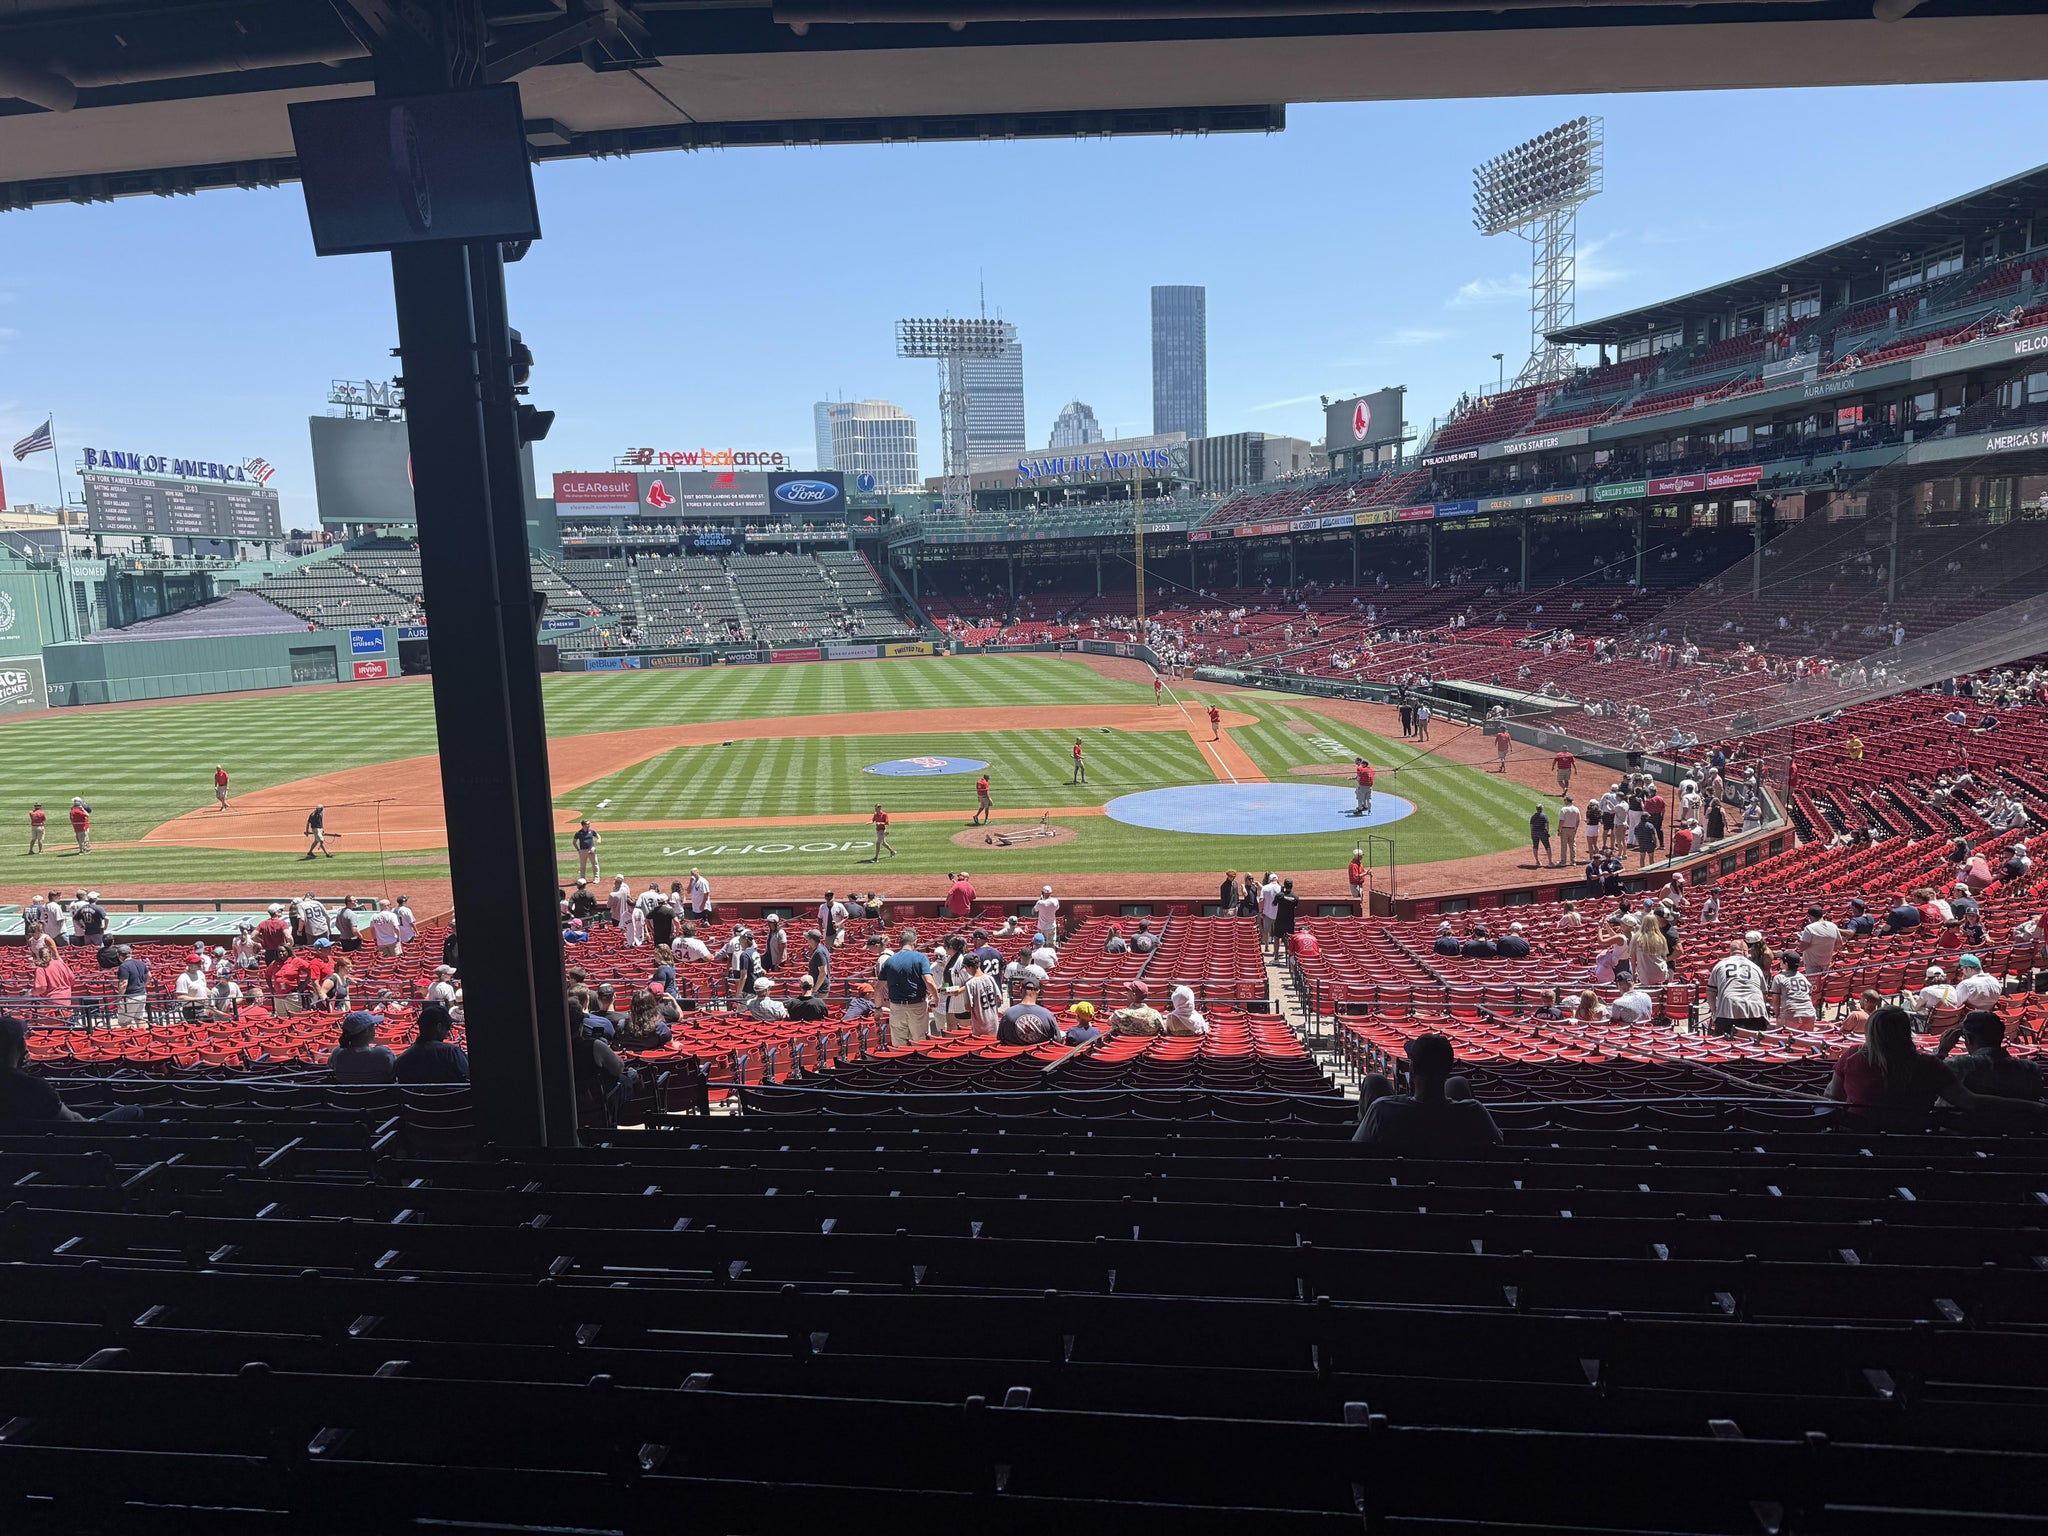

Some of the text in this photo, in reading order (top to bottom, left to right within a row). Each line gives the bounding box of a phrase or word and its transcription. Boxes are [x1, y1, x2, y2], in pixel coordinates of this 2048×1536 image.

[1825, 378, 1855, 393] PAVILION
[1503, 437, 1559, 454] TODAY'S STARTERS
[1986, 431, 2039, 451] AMERICA'S
[84, 447, 246, 481] BANK OF AMERICA
[1429, 456, 1445, 466] BLACK
[1445, 454, 1458, 464] LIVES
[1458, 451, 1478, 461] MATTER
[1017, 447, 1170, 483] SAMUEL ADAMS
[97, 475, 110, 483] YORK
[111, 477, 134, 485] YANKEES
[134, 478, 155, 487] LEADERS
[1708, 475, 1733, 487] Safelite
[183, 484, 199, 494] 12:03
[562, 482, 630, 493] CLEAResult
[787, 483, 826, 501] Ford
[1623, 485, 1645, 495] PICKLES
[1490, 501, 1503, 509] COLE
[1525, 497, 1532, 505] VS
[1542, 494, 1564, 504] BENNETT
[1151, 524, 1170, 532] 12:03
[693, 538, 732, 546] ORCHARD
[698, 532, 725, 540] ANGRY
[71, 567, 105, 577] ABIOMED
[651, 655, 701, 667] GRANITE CITY
[728, 651, 758, 661] wasabi
[358, 665, 382, 675] IRVING
[588, 658, 617, 670] jetBlue
[48, 685, 64, 693] 379
[662, 841, 875, 857] WHOOP
[1303, 938, 1313, 951] 2
[674, 949, 691, 961] 34
[982, 958, 1000, 975] 23
[1724, 963, 1751, 979] 23
[1790, 978, 1807, 992] 99
[979, 992, 997, 1009] 99
